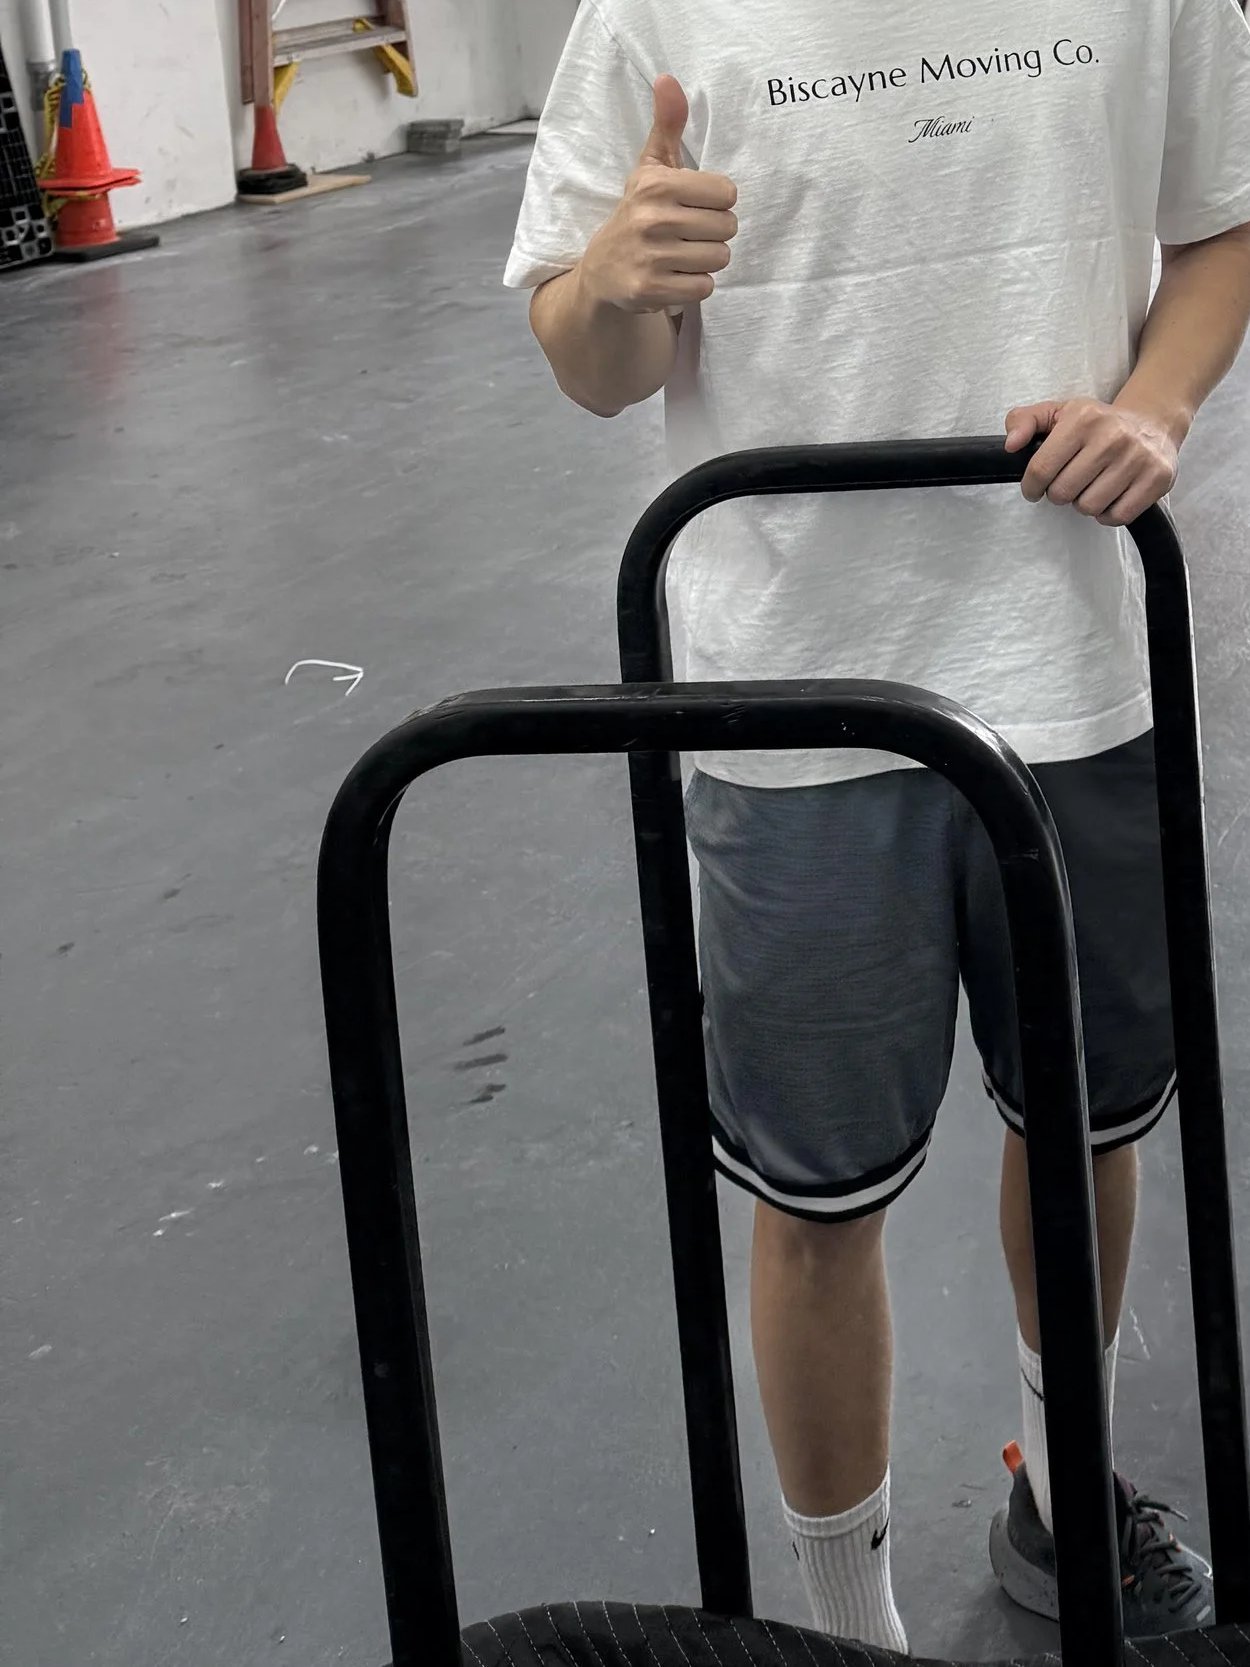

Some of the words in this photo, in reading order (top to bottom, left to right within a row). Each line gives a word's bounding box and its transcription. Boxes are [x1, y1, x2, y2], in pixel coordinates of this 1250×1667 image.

[767, 68, 907, 105] Biscayne
[921, 47, 1042, 83] Moving
[1053, 39, 1100, 65] Co.
[908, 115, 975, 143] Miami
